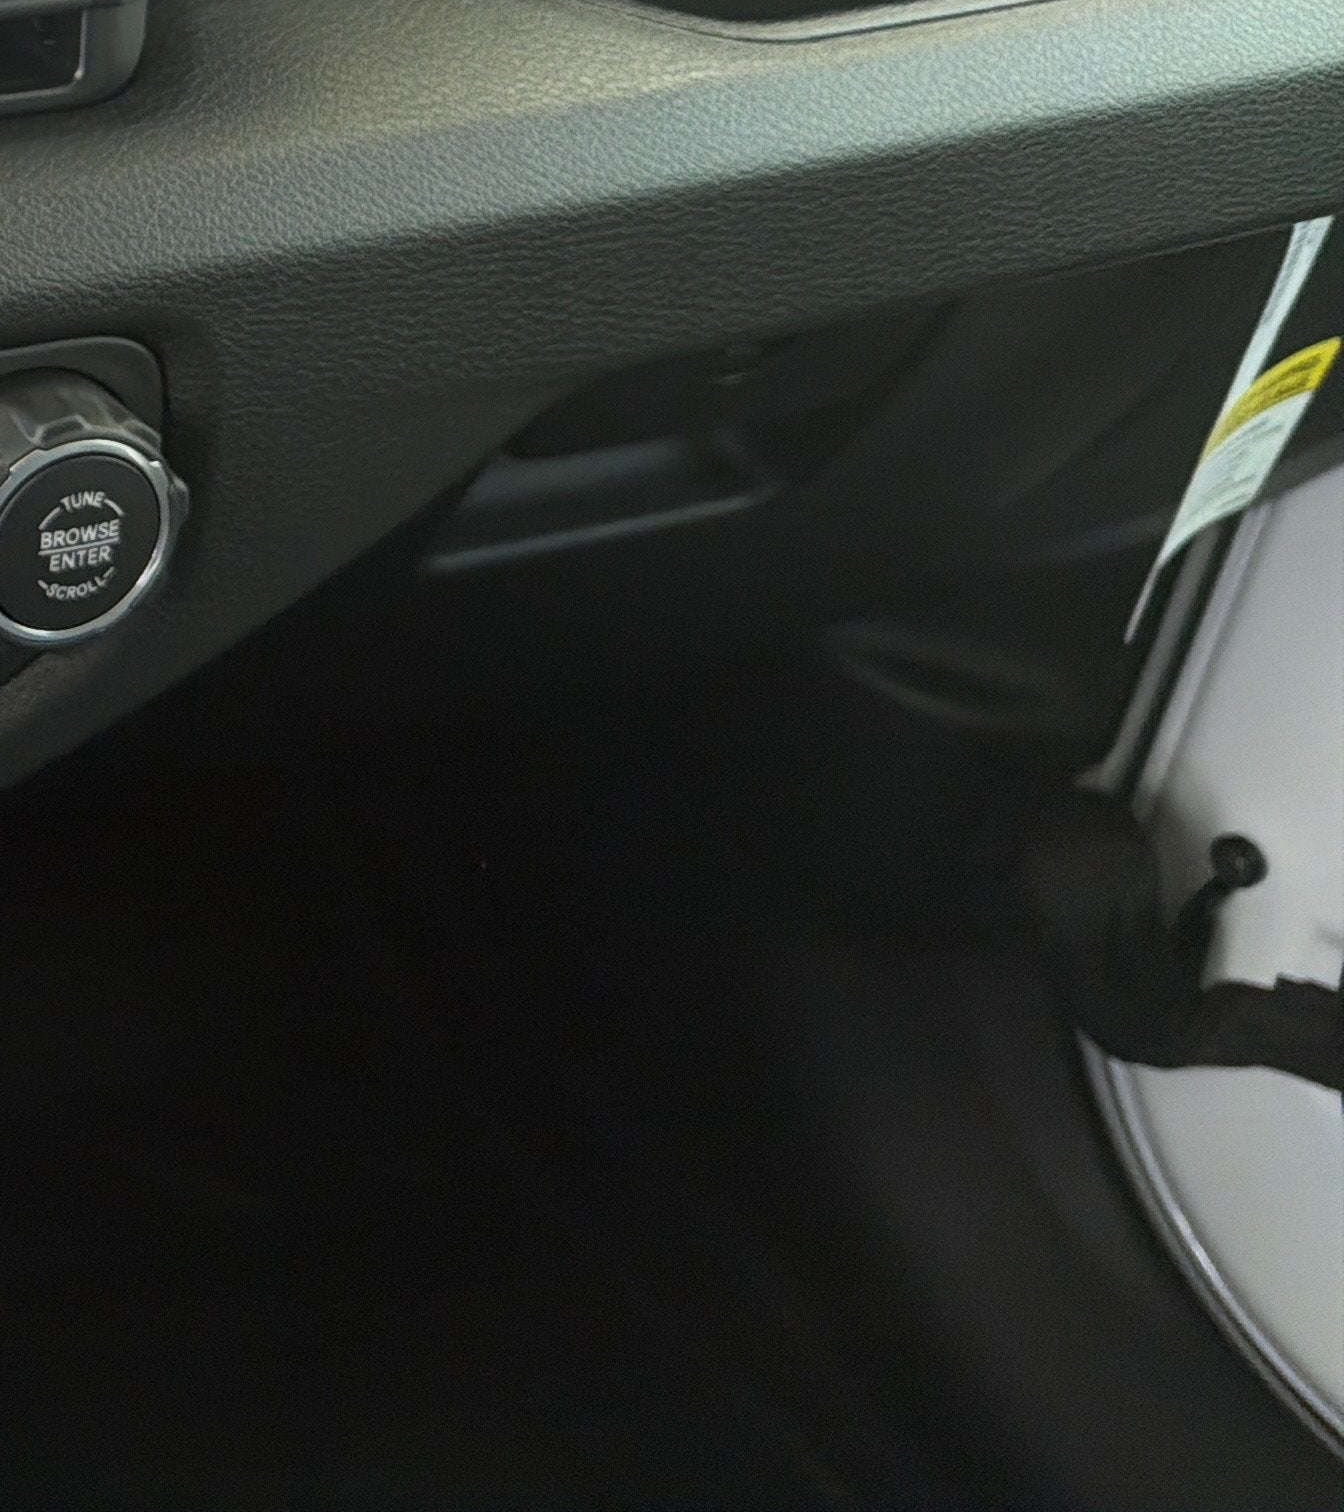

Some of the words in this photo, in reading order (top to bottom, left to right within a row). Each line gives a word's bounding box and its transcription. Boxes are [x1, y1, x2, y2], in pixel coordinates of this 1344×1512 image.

[60, 491, 106, 512] TUNE
[40, 519, 120, 551] BROWSE
[49, 545, 112, 573] ENTER
[45, 576, 107, 601] SCROLL
